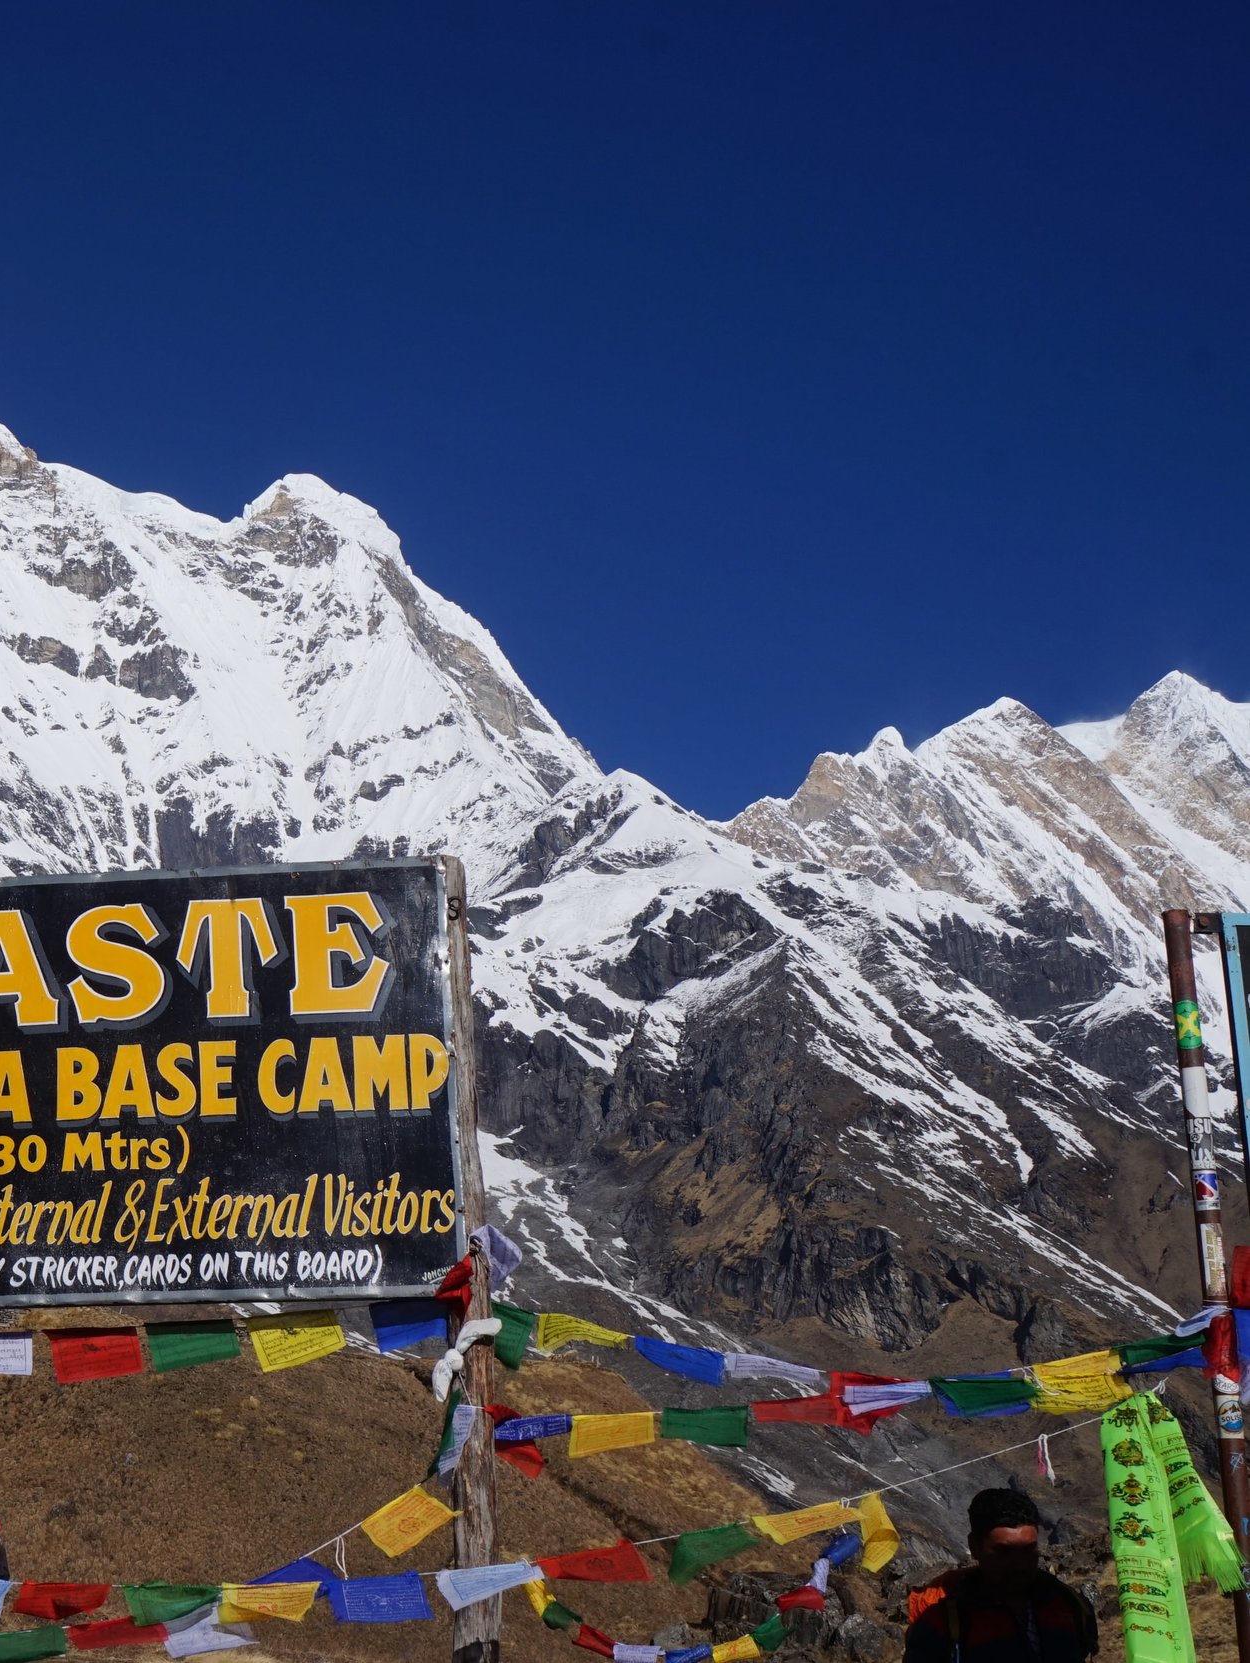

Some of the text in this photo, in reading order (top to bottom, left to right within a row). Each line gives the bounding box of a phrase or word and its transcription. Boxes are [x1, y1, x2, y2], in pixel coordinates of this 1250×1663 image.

[56, 1041, 237, 1121] BASE
[258, 1034, 449, 1114] CAMP
[61, 1125, 190, 1174] Mtrs)
[323, 1171, 456, 1240] Visitors
[199, 1251, 231, 1282] ON
[234, 1250, 291, 1283] THIS
[296, 1244, 382, 1285] BOARD)
